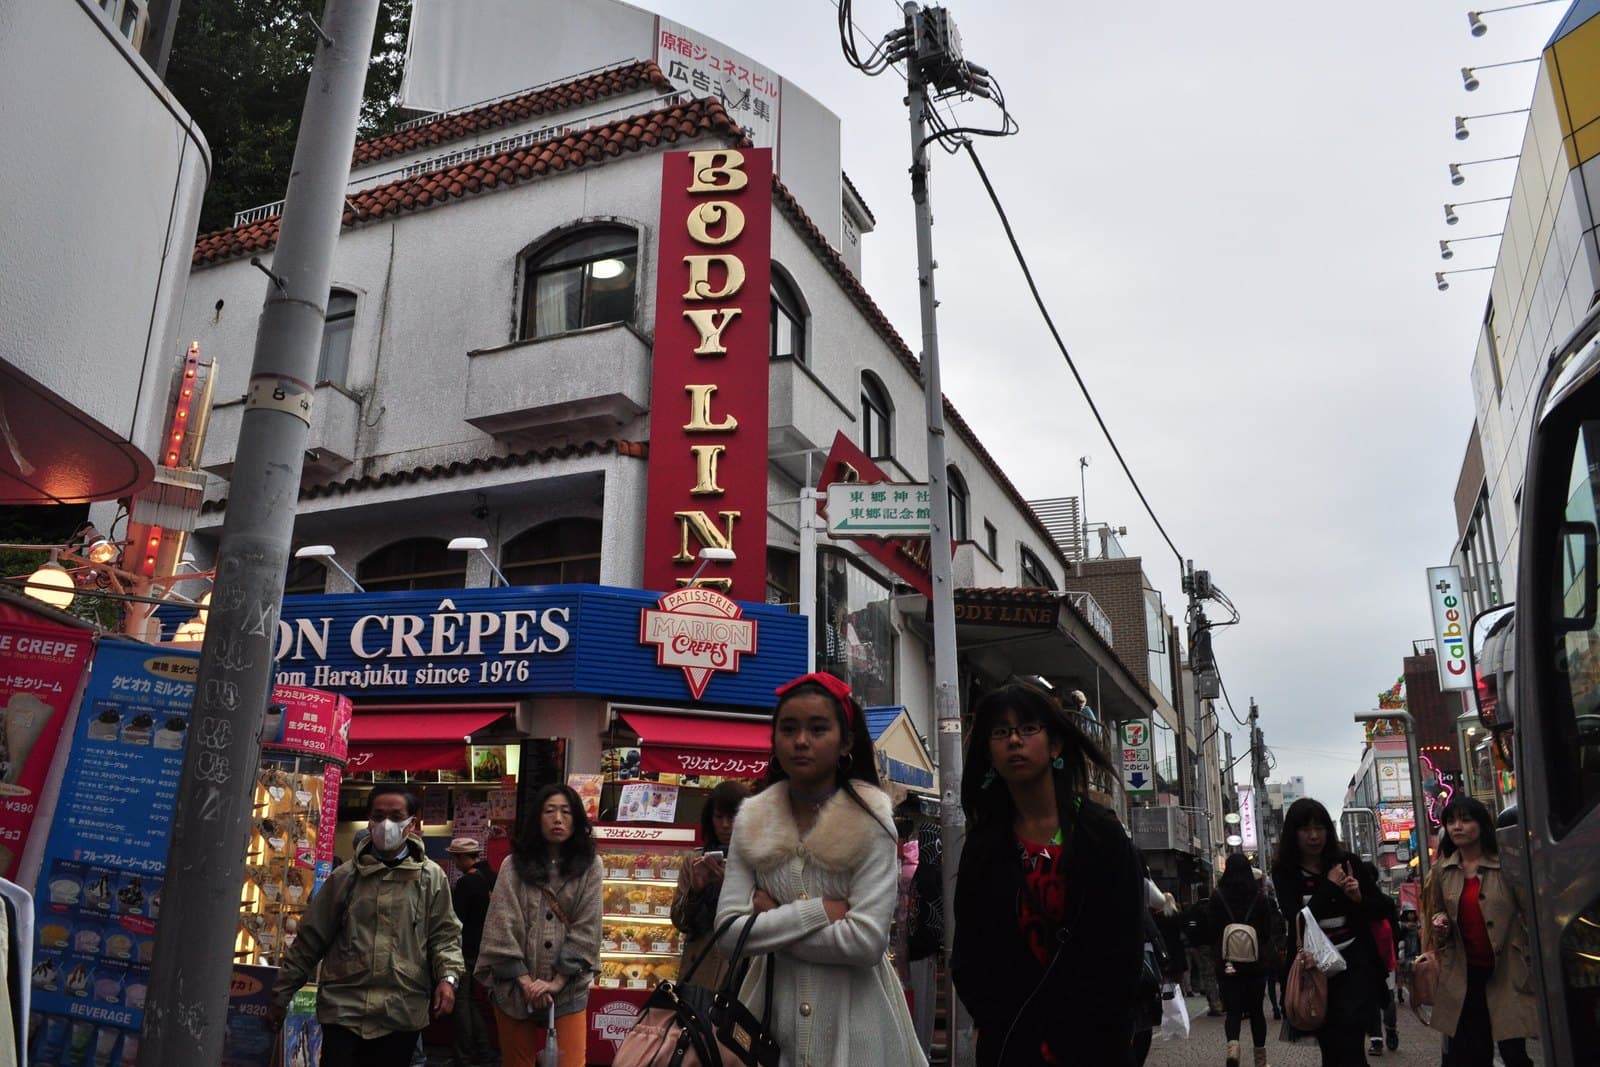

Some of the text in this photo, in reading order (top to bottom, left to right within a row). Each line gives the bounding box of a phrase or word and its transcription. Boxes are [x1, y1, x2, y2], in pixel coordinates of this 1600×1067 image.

[660, 31, 778, 98] 原宿ジュネスビル
[682, 149, 749, 355] BODY
[672, 384, 742, 593] LIN
[668, 590, 734, 613] PATISSERIE
[999, 605, 1052, 625] LINE
[350, 598, 571, 660] CRÊPES
[652, 617, 749, 646] MARION
[1443, 595, 1467, 676] Calbee
[16, 637, 78, 659] CREPE
[671, 634, 729, 667] CREPES
[112, 674, 152, 694] タピオカ
[275, 660, 530, 688] om Harajuku since 1976
[303, 739, 326, 750] ¥320
[677, 754, 769, 774] マリオンクレープ
[1123, 763, 1150, 772] このビル
[5, 799, 34, 814] ¥390
[603, 828, 663, 840] マリオンクレープ
[82, 850, 167, 872] フルーツスムージー&フロ
[71, 1002, 133, 1025] BEVERAGE
